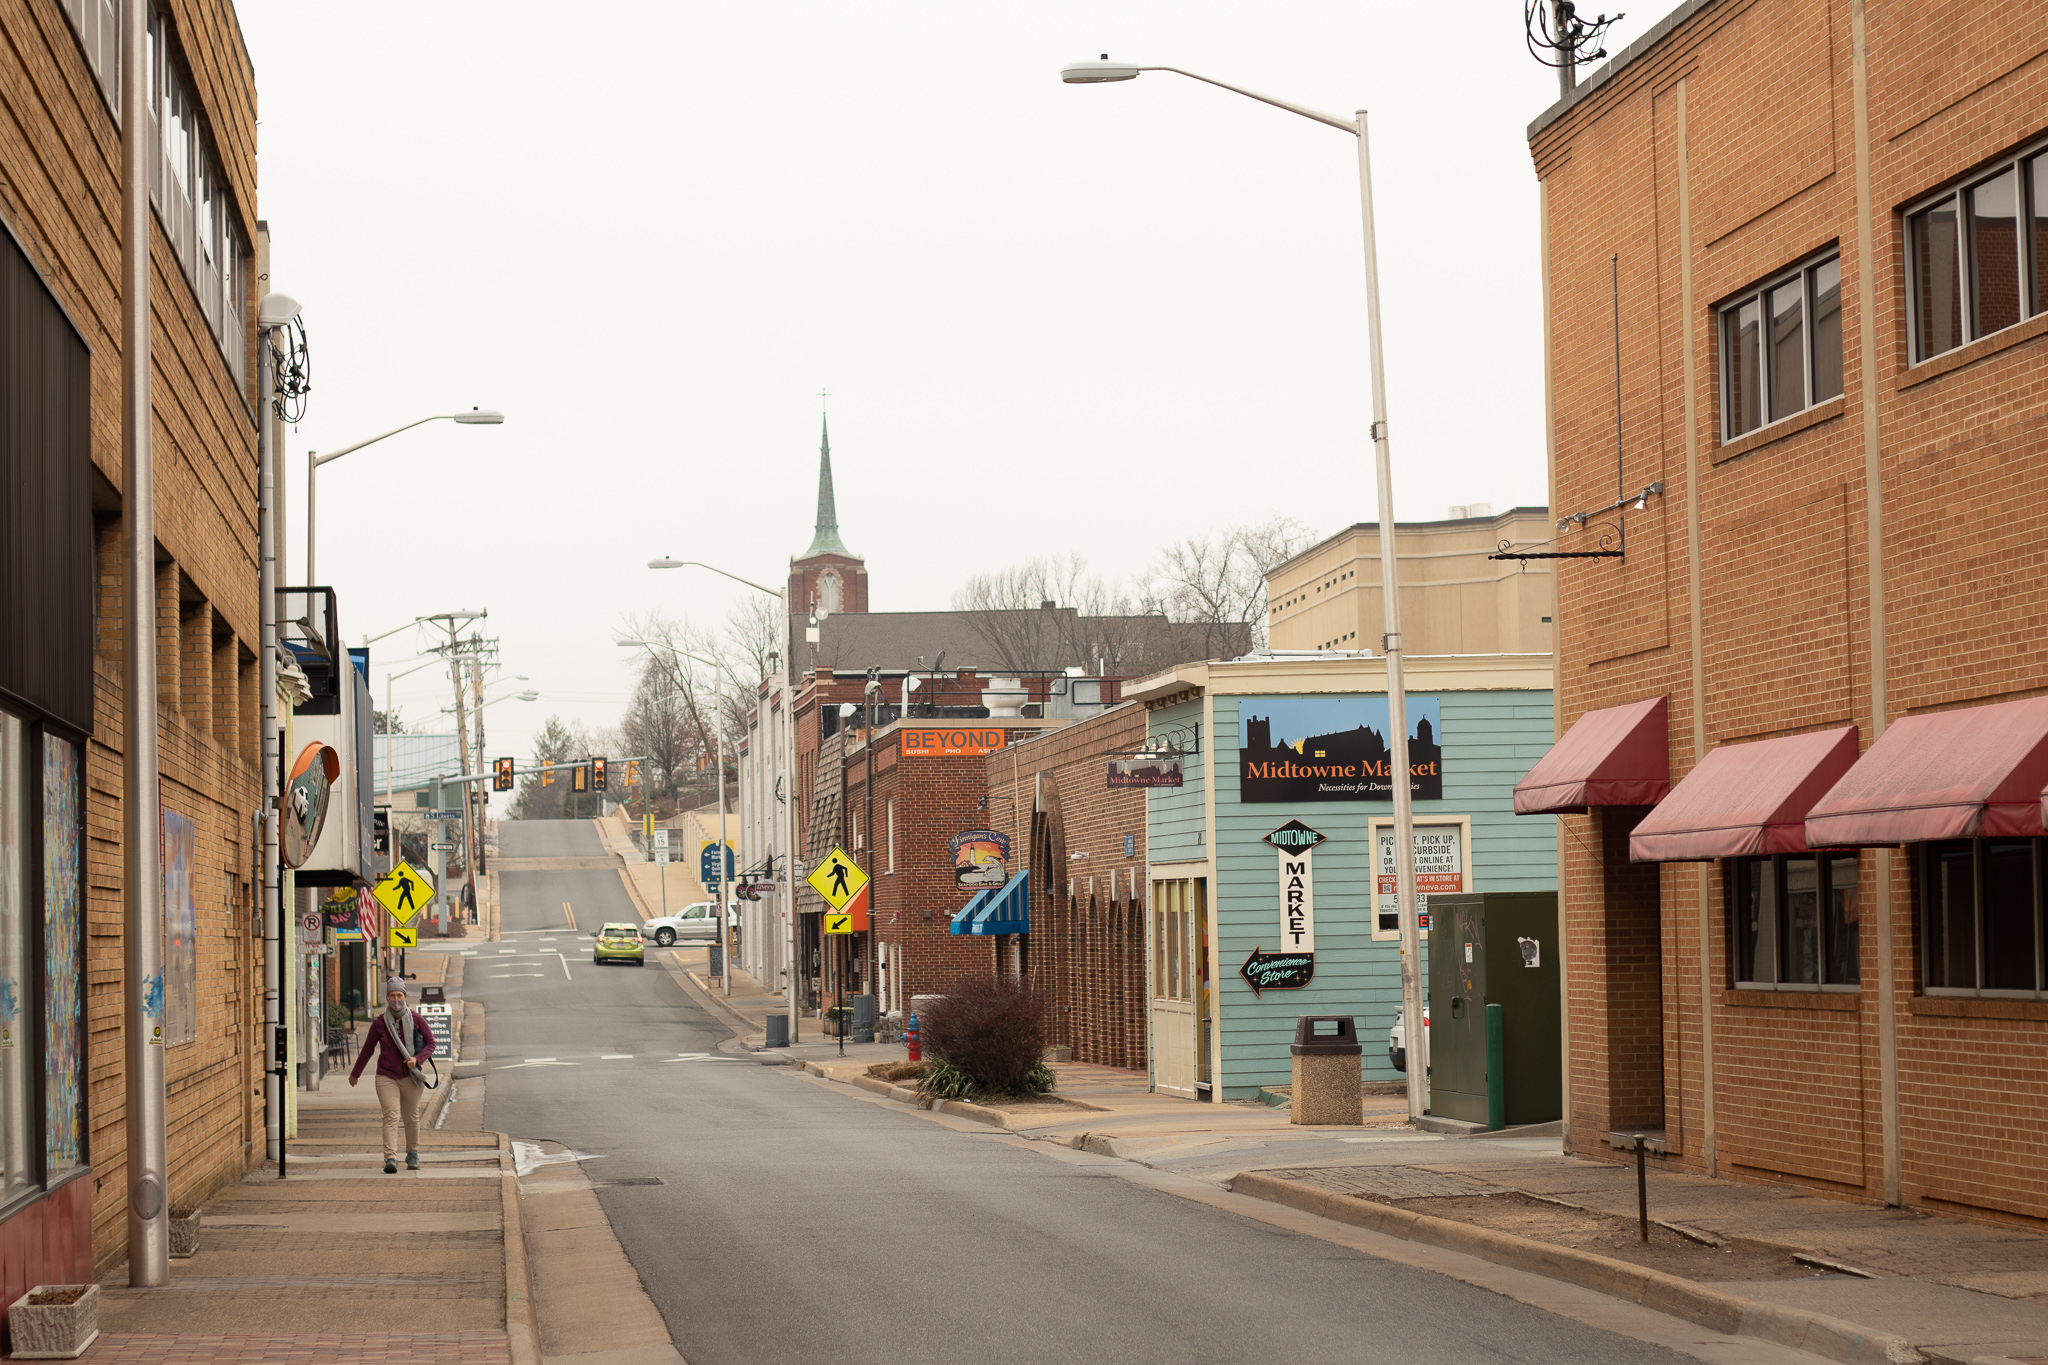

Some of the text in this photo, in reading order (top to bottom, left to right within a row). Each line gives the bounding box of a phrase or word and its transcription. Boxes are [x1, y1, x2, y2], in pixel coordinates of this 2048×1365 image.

[906, 731, 1000, 748] BEYOND
[1246, 760, 1438, 779] Midtowne Maket
[1110, 776, 1180, 784] Midtowne Market
[1318, 782, 1356, 792] Necessities
[1355, 782, 1368, 794] for
[988, 832, 1006, 844] Cove
[1270, 829, 1318, 846] MIDTOWNE
[1380, 836, 1394, 846] PIC
[1422, 836, 1440, 845] PICK
[1443, 835, 1455, 844] UP,
[1386, 846, 1392, 856] &
[1384, 858, 1393, 866] OR
[1286, 862, 1306, 944] MARKET
[1247, 958, 1312, 976] Convenience
[1260, 969, 1298, 986] Store
